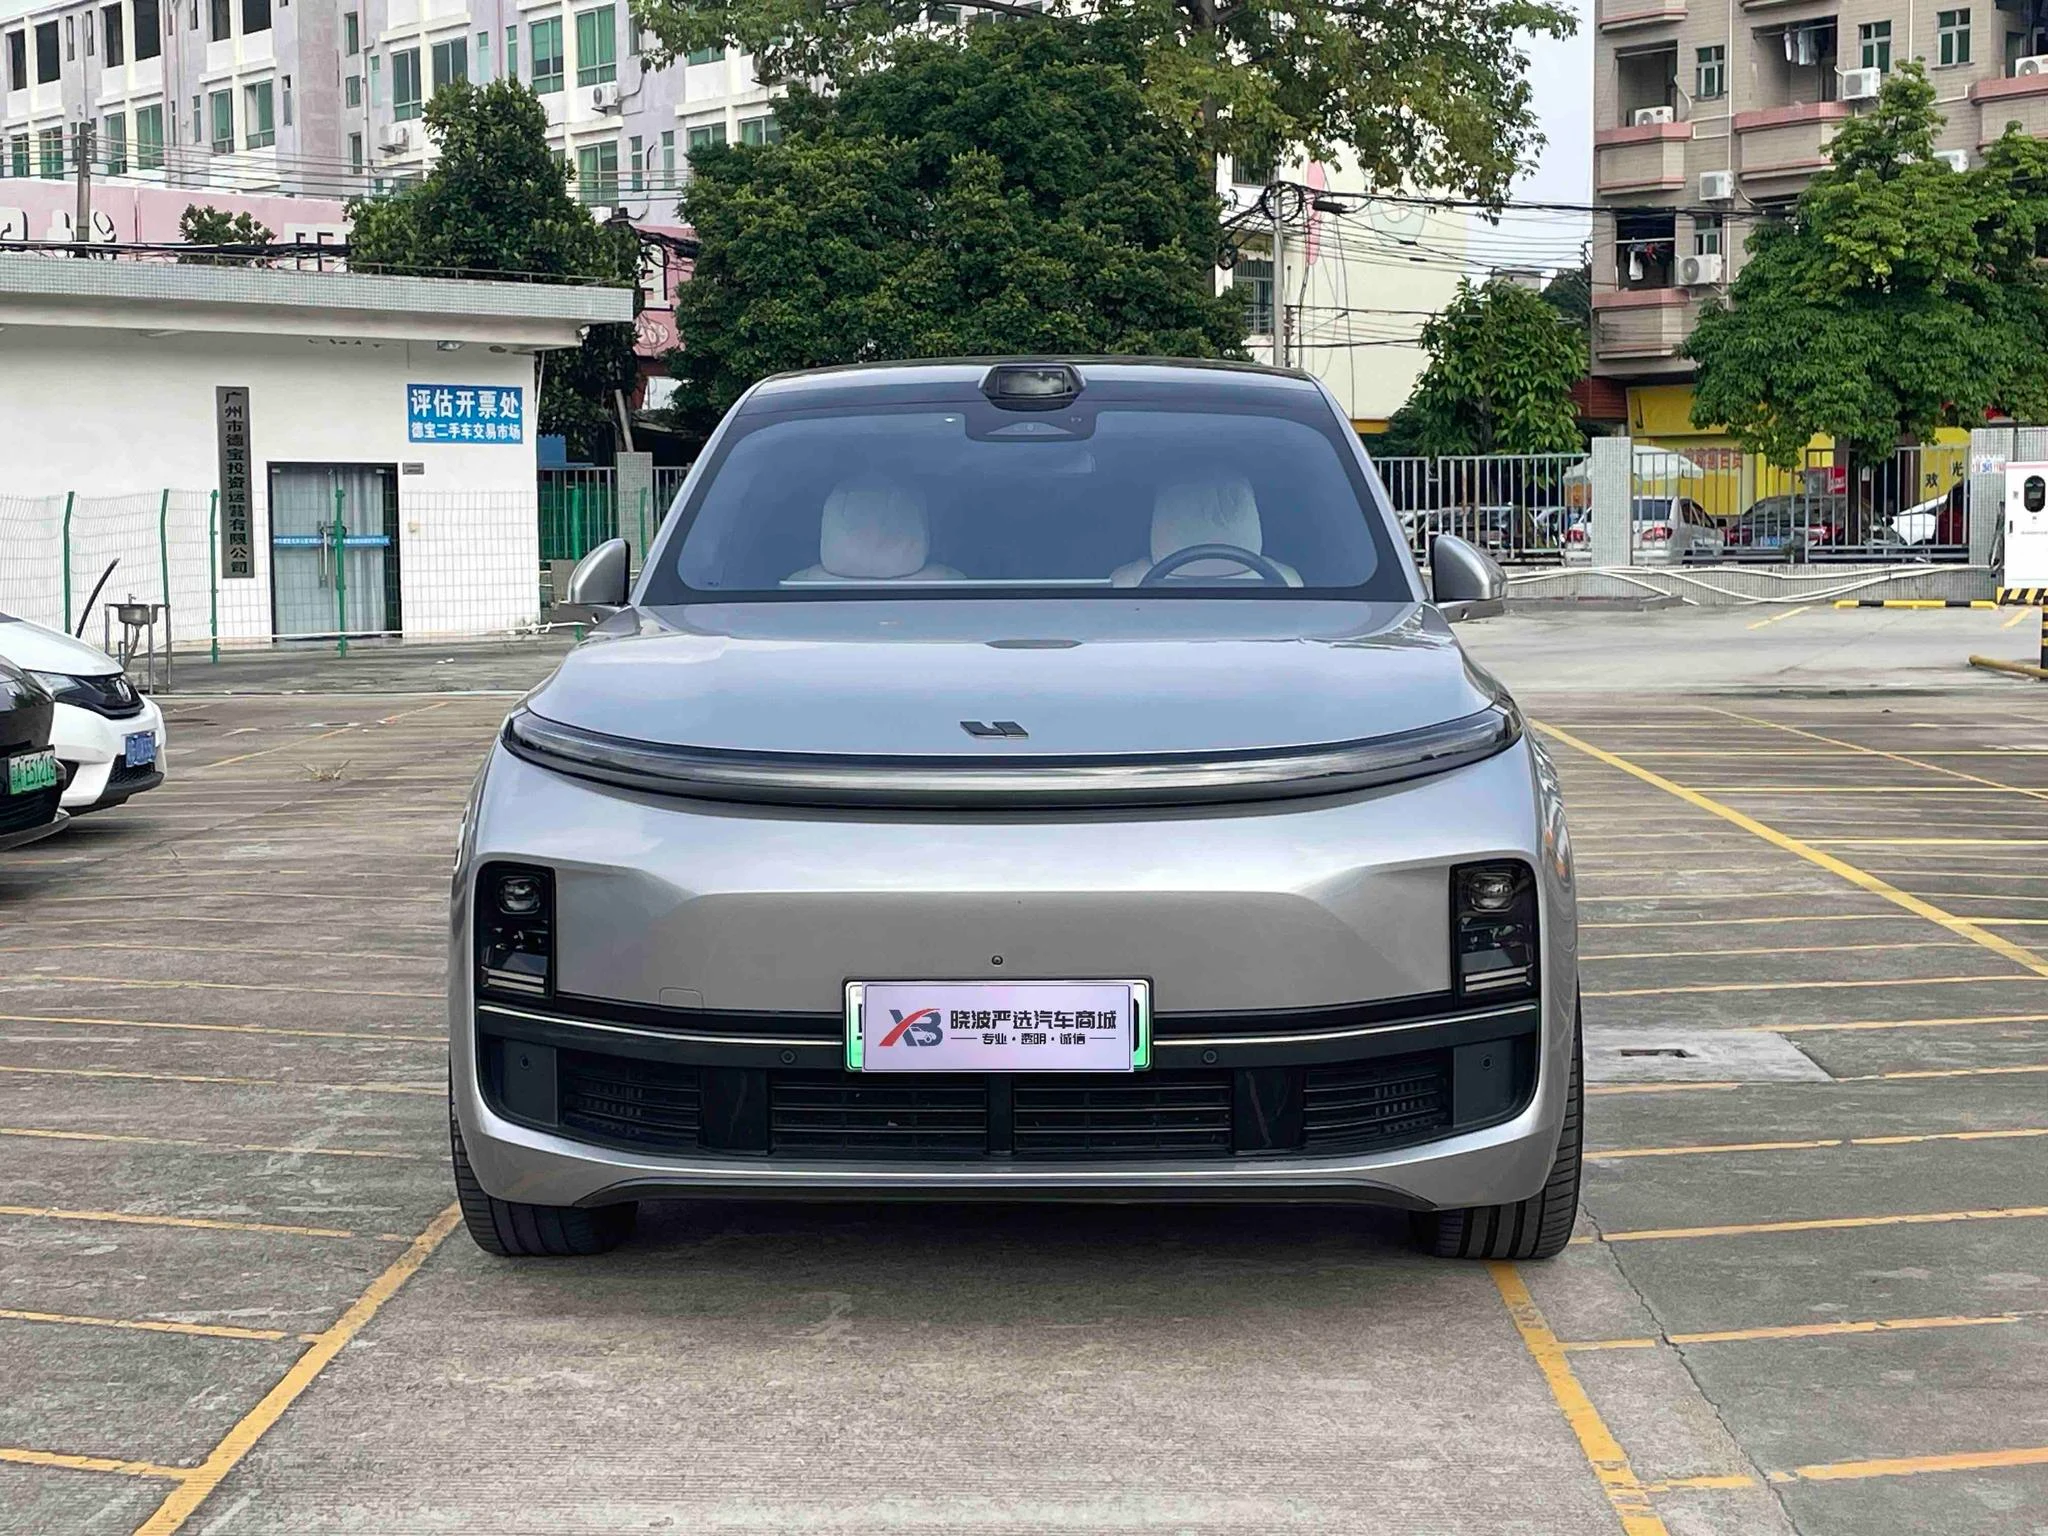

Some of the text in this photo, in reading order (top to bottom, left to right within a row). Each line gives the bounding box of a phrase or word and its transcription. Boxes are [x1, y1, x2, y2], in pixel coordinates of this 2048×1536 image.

[411, 389, 520, 419] 评估开票处
[411, 422, 521, 440] 德宝二手车交易市场
[224, 391, 248, 574] 广州市德宝投资运营有限公司
[950, 1010, 1117, 1029] 晓波严选汽车商城
